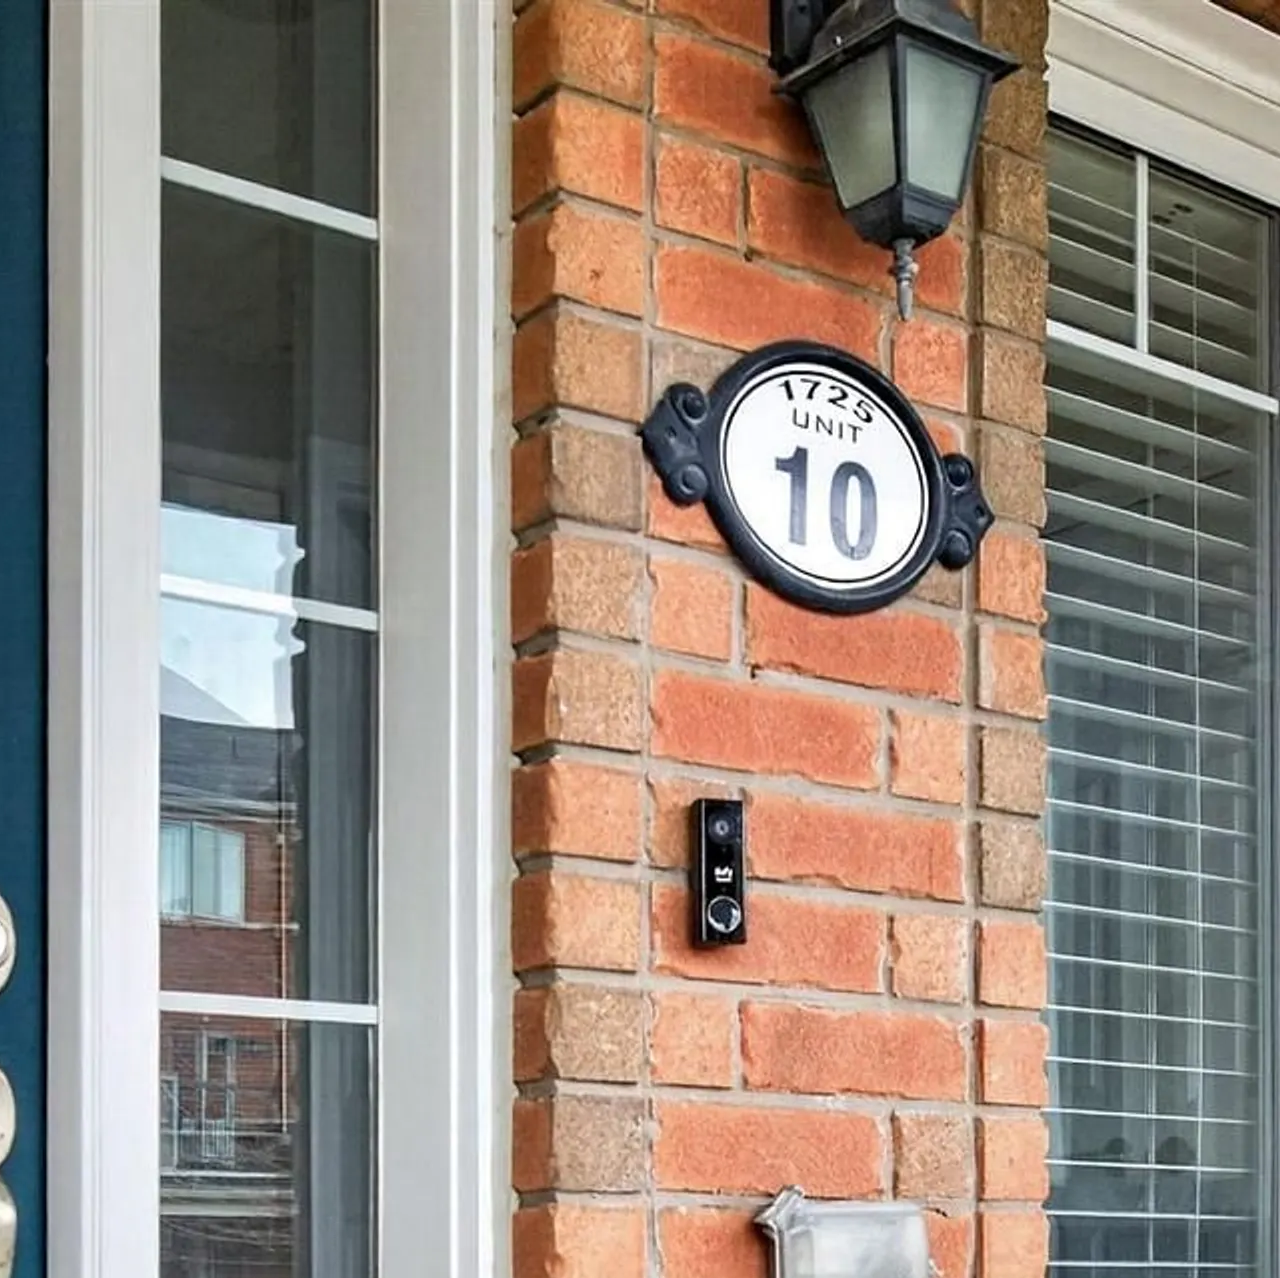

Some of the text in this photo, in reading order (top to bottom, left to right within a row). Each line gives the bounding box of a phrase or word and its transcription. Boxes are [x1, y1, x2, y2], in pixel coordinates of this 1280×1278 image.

[778, 378, 875, 423] 1725
[792, 407, 863, 443] UNIT
[775, 445, 878, 561] 10
